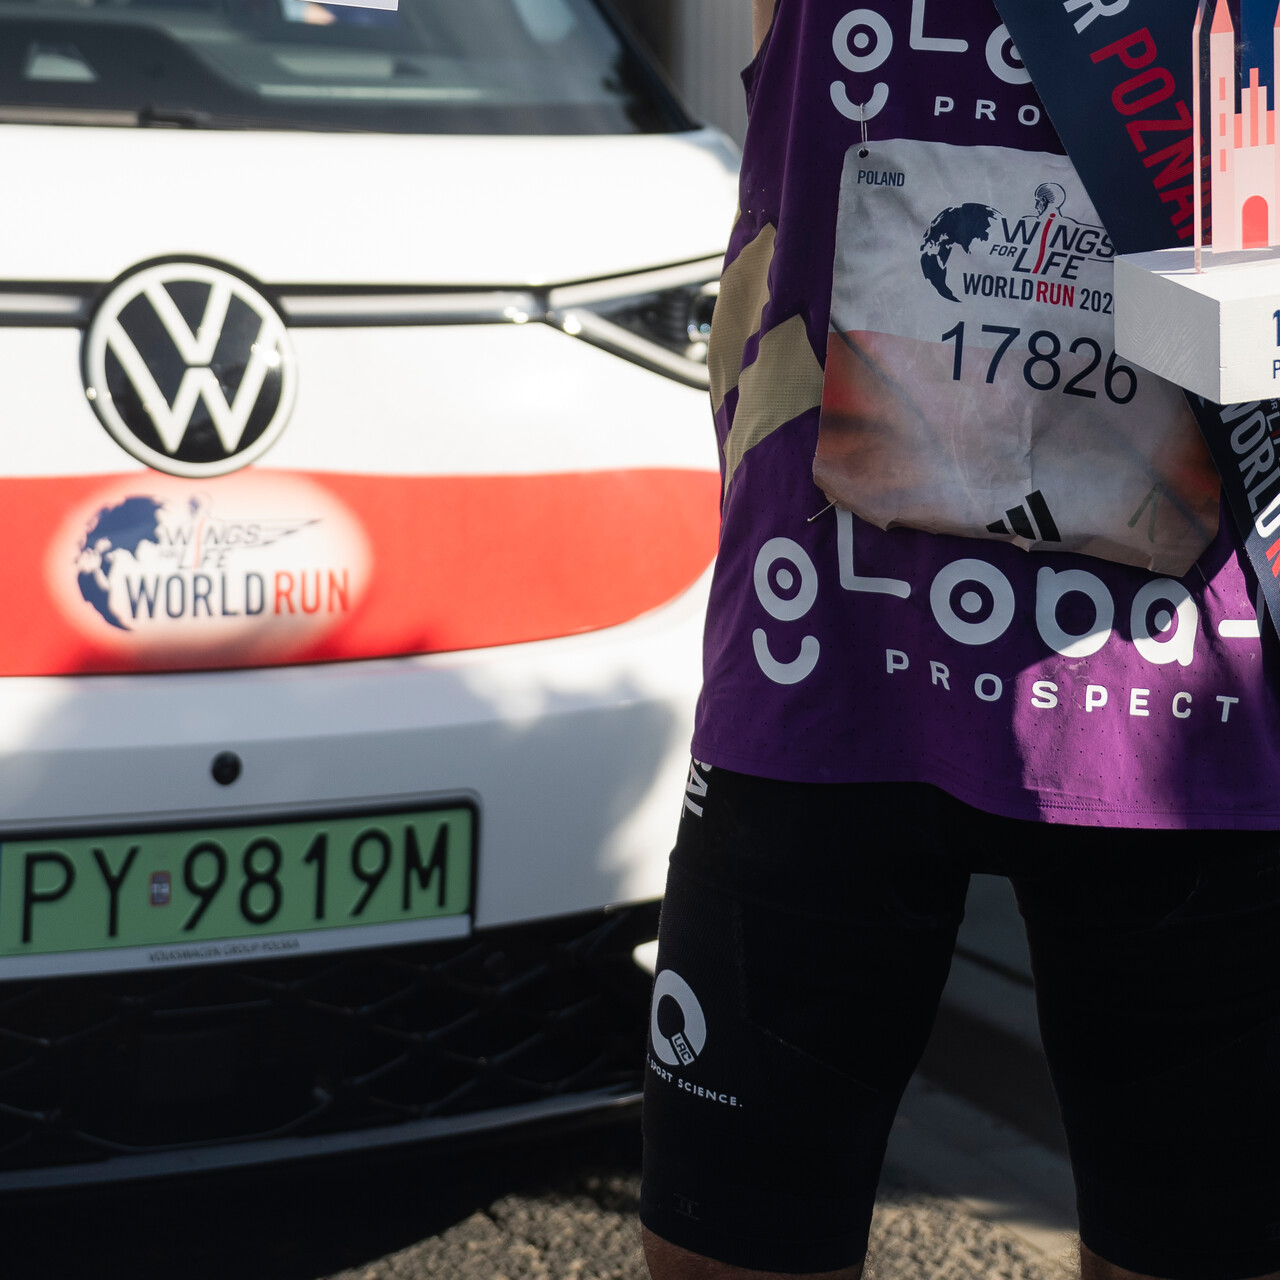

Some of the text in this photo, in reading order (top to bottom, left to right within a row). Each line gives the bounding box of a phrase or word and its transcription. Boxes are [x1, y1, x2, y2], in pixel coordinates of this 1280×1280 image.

[1089, 27, 1212, 246] POZNA
[857, 170, 905, 187] POLAND
[989, 244, 1017, 258] FOR
[963, 273, 1115, 315] WORLD RUN 202
[941, 321, 1138, 405] 17826
[125, 568, 350, 619] WORLD RUN
[886, 649, 1240, 723] PROSPECT
[21, 822, 450, 944] PY 9819M
